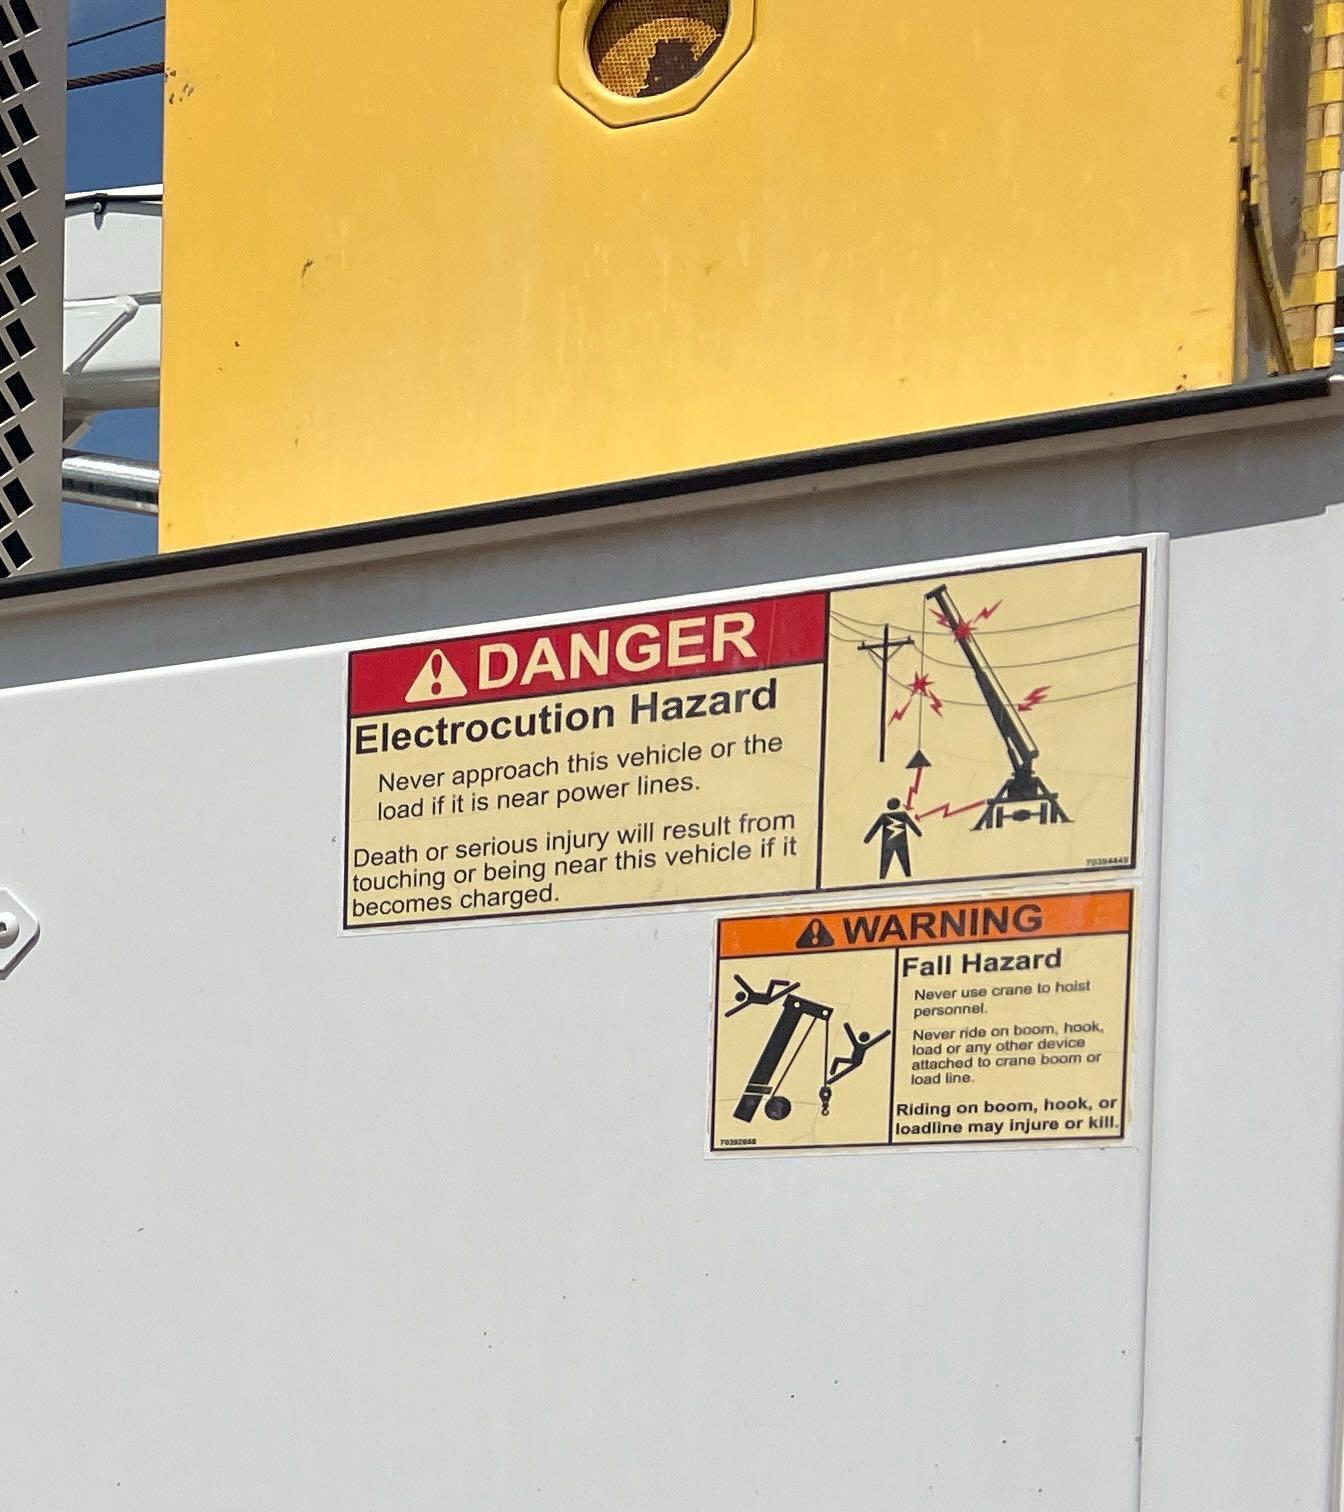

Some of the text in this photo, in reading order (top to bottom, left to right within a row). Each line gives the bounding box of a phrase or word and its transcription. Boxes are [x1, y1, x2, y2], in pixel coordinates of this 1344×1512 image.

[478, 611, 758, 690] DANGER
[355, 677, 777, 755] Electrocution Hazard
[378, 733, 783, 793] Never approach this vehicle or the
[377, 774, 700, 821] load if it is near power lines.
[353, 812, 795, 868] Death or serious injury will result from
[352, 835, 797, 892] touching or being near this vehicle if it
[352, 882, 560, 918] becomes charged.
[842, 903, 1044, 945] WARNING
[902, 947, 1063, 978] Fall Hazard
[914, 979, 1091, 1001] Never use crane to hoist
[913, 1002, 989, 1019] personnel.
[912, 1020, 1104, 1041] Never ride on boom, hook,
[912, 1036, 1086, 1056] load or any other device
[911, 1051, 1102, 1071] attached to crane boom or
[911, 1072, 941, 1085] load
[896, 1096, 1118, 1118] Riding on boom, hook, or
[895, 1115, 1120, 1136] loadline may injure or kill.
